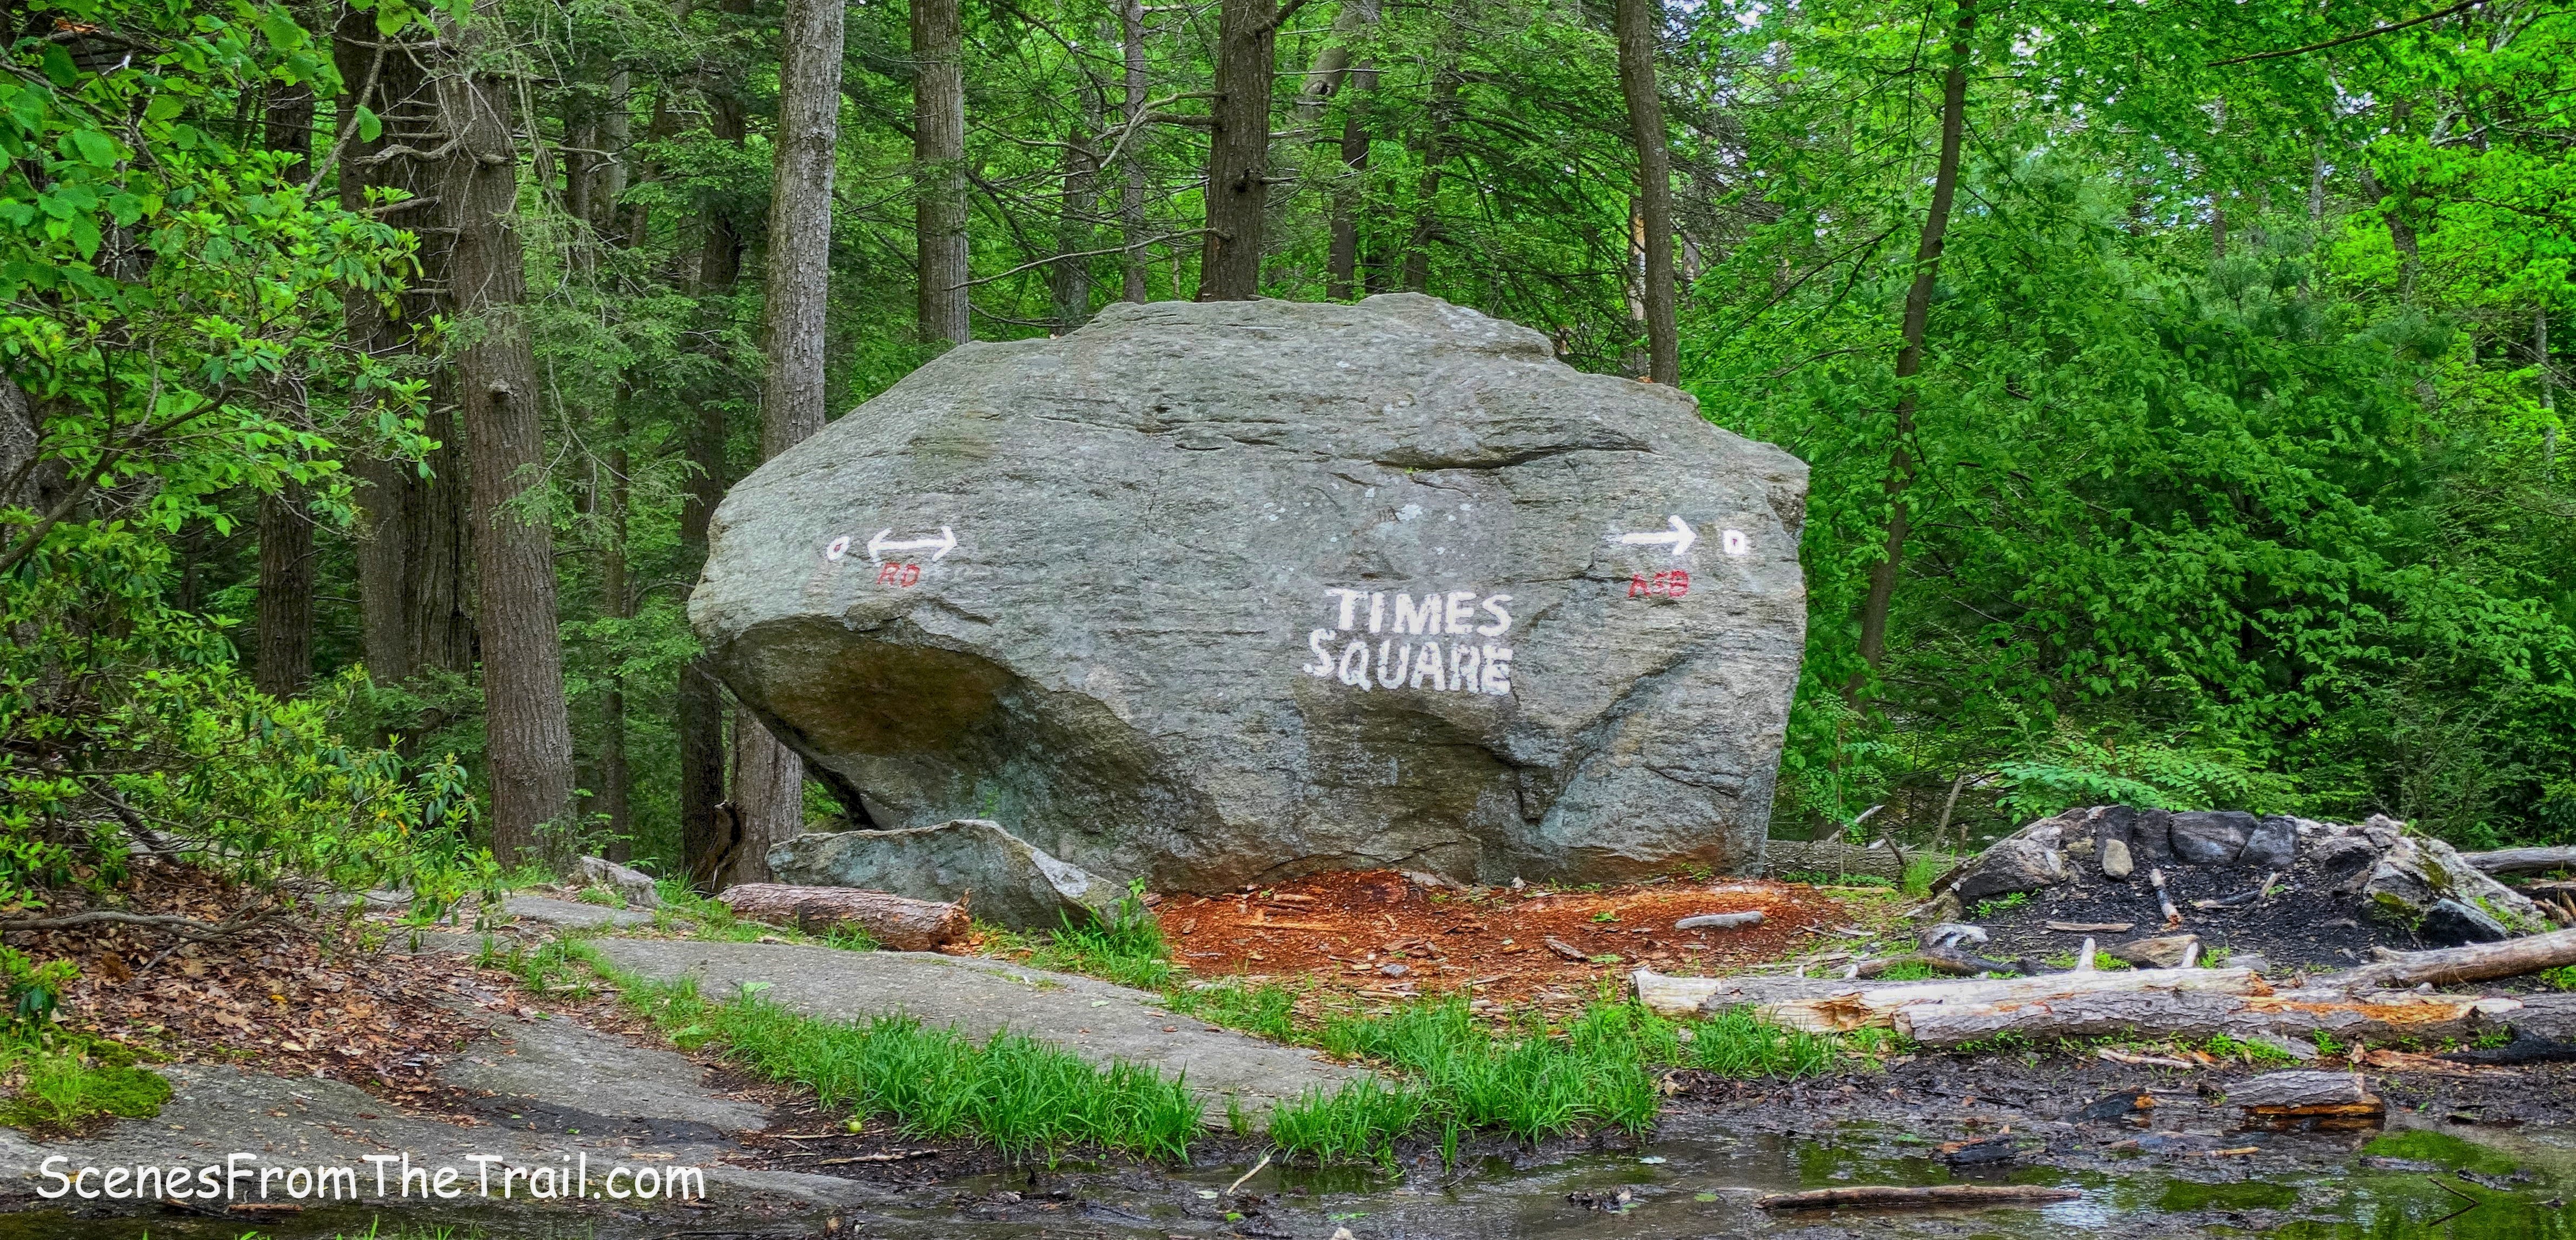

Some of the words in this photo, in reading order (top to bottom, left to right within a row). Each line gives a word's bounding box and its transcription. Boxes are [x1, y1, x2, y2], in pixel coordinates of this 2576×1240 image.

[877, 562, 920, 588] RD
[1324, 588, 1513, 637] TIMES
[1303, 628, 1513, 695] SQUARE
